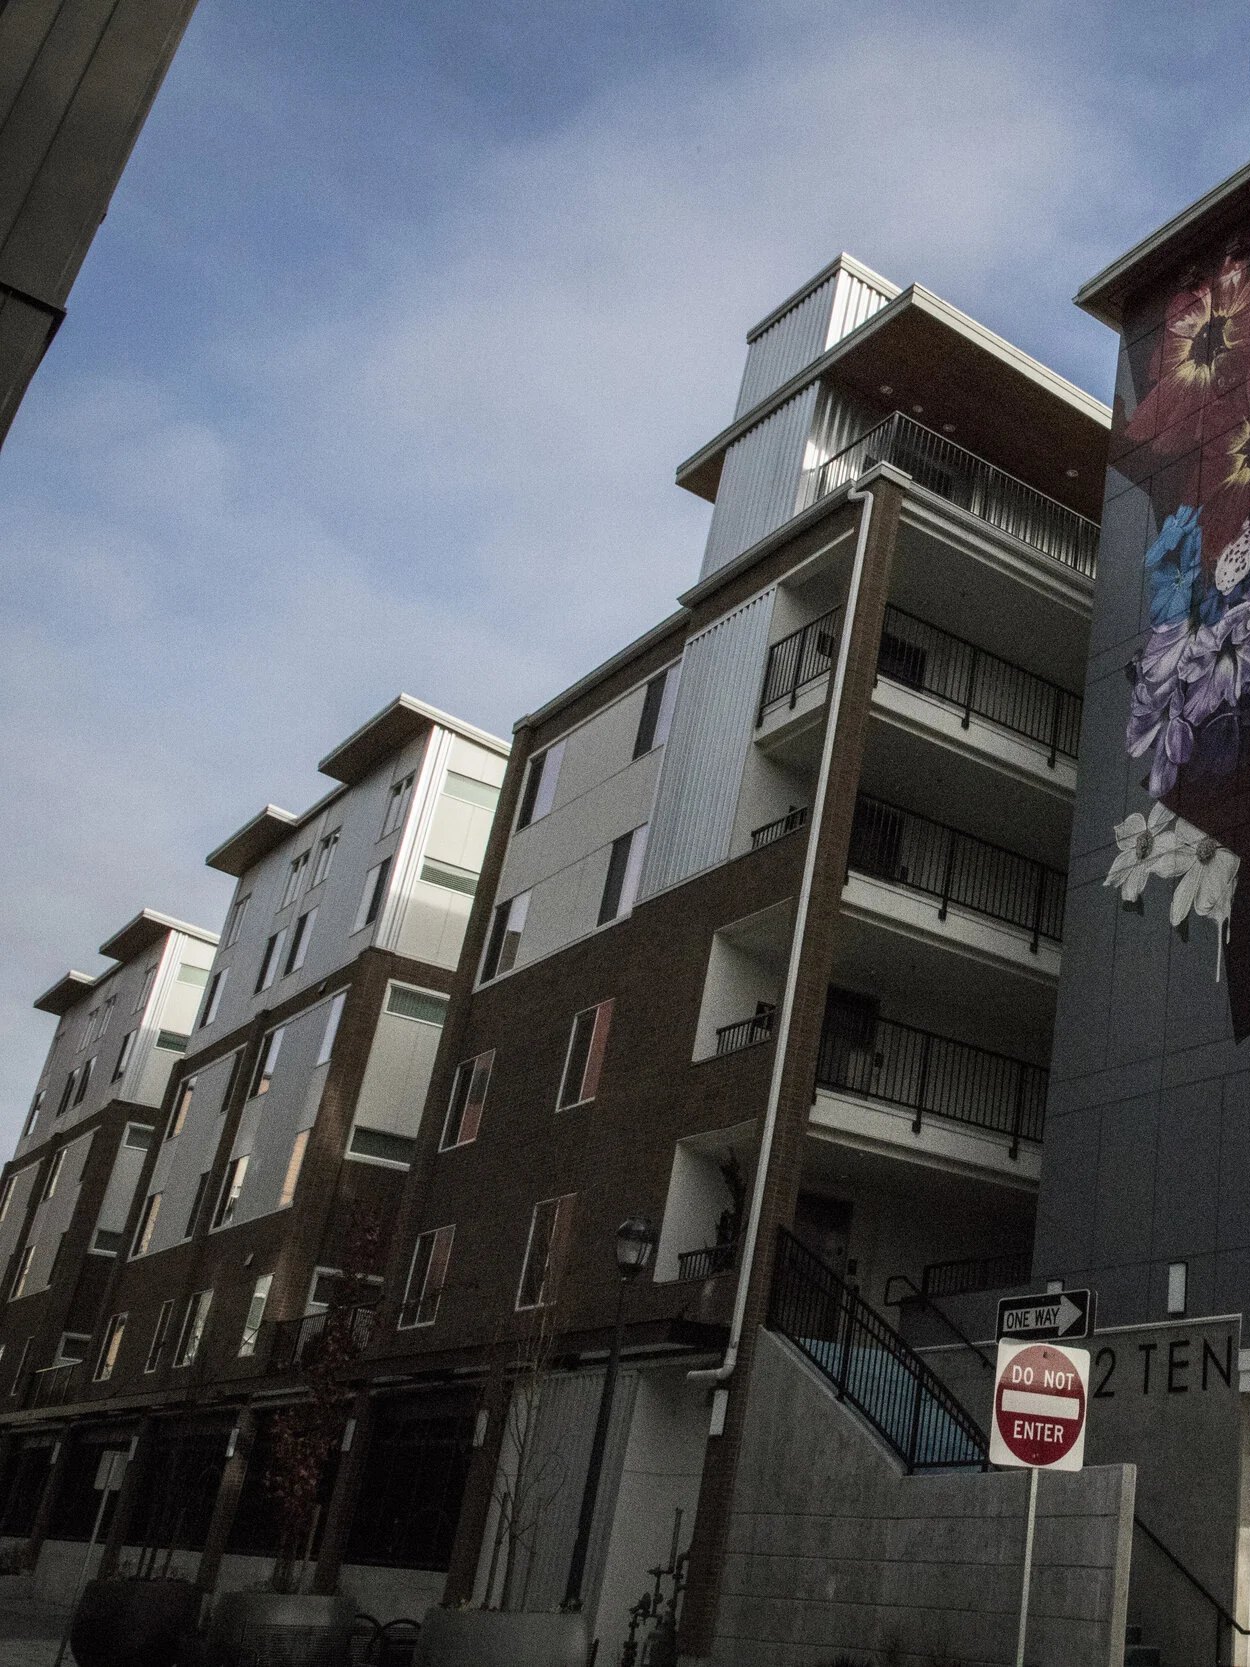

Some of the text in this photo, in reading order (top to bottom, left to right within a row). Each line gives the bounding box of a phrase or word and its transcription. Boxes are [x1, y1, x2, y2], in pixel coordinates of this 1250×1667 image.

[1006, 1307, 1060, 1329] ONE WAY
[1139, 1336, 1233, 1395] TEN
[1012, 1365, 1074, 1391] DO NOT
[1013, 1421, 1064, 1443] ENTER
